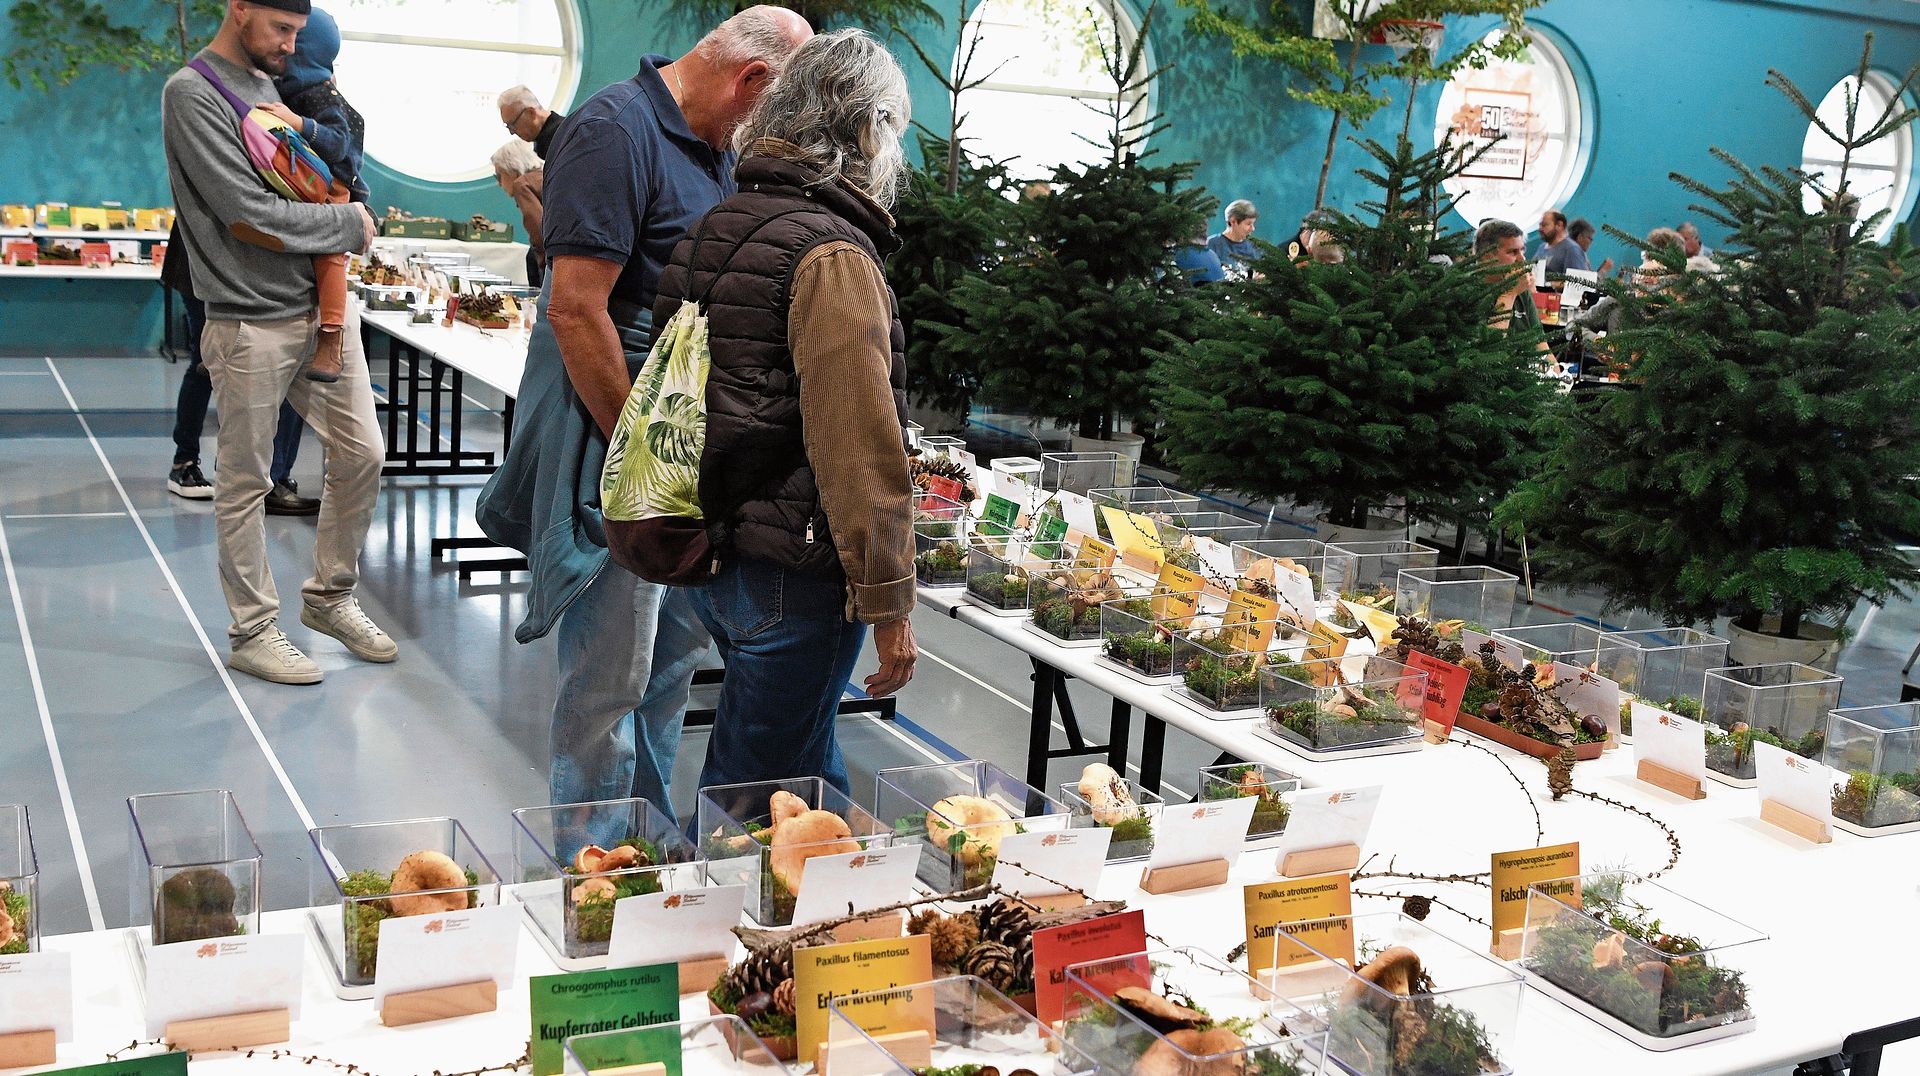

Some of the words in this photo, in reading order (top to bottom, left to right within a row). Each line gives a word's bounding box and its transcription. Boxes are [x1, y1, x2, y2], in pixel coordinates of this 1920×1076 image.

[1481, 107, 1499, 130] 50
[1499, 854, 1545, 869] Hygrophoropsis
[1546, 850, 1574, 862] aurantiaca
[1258, 888, 1285, 900] Paxillus
[1286, 883, 1339, 897] atrotomentosus
[1500, 884, 1531, 902] Falsche
[1057, 929, 1086, 941] Paxillus
[1088, 922, 1121, 934] involutus
[1253, 913, 1348, 939] Samuss-Krempling
[815, 953, 851, 967] Paxillus
[853, 947, 910, 962] filamentosus
[551, 977, 628, 994] Chroogomphus
[630, 973, 661, 986] rutilus
[1049, 966, 1082, 985] Kaer
[540, 1018, 619, 1043] Kupferroter
[621, 1010, 675, 1028] Gelbfuss
